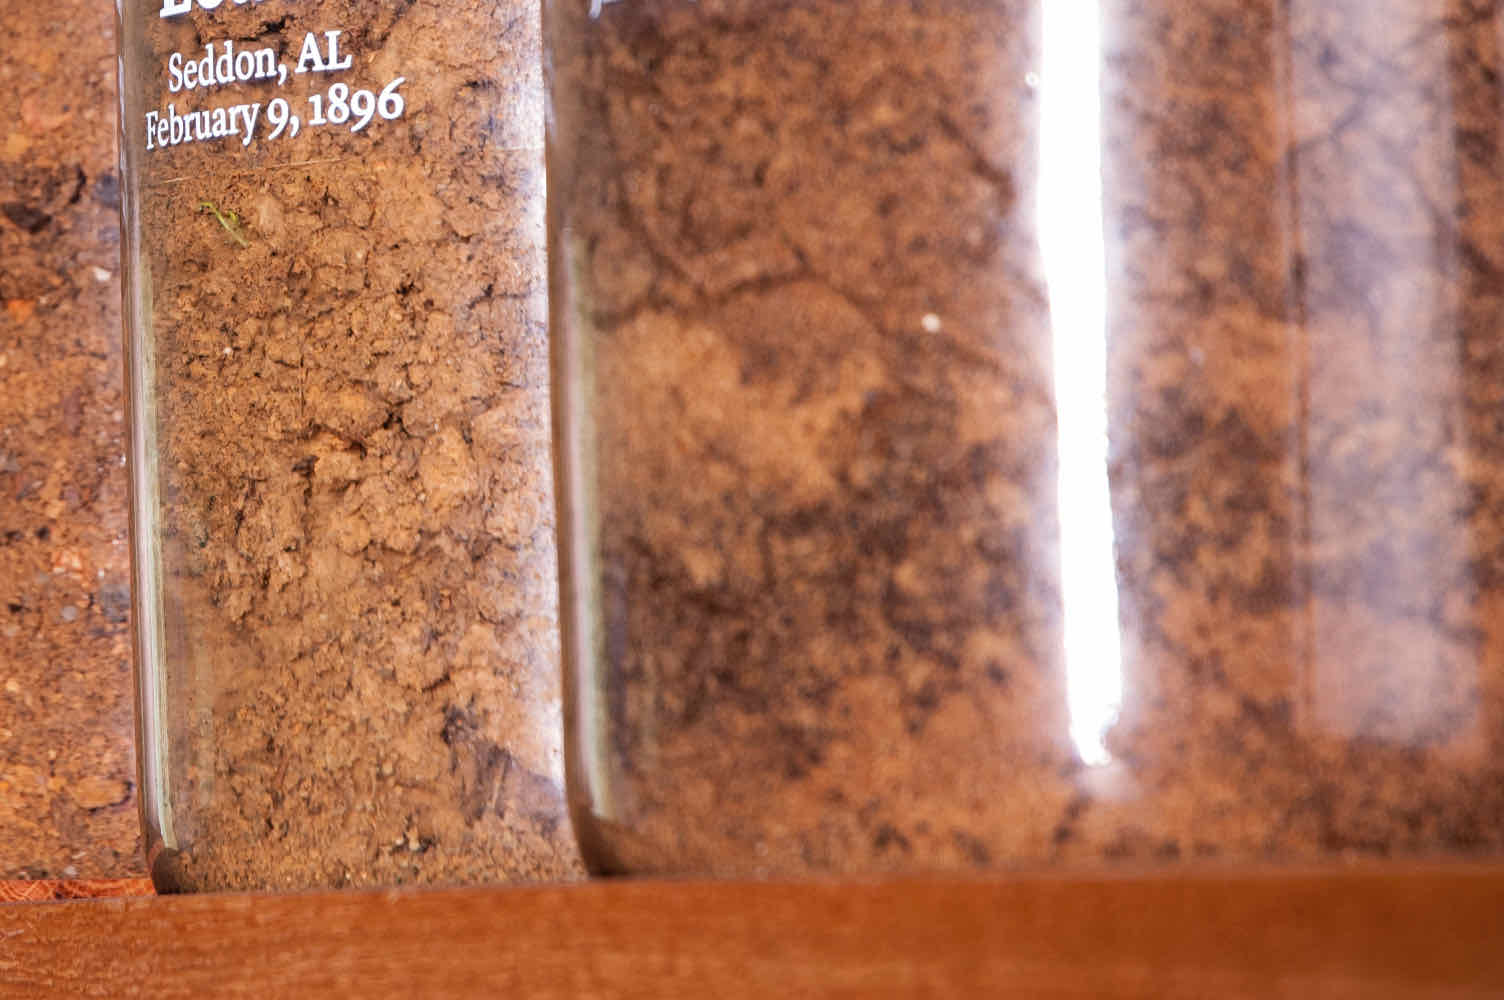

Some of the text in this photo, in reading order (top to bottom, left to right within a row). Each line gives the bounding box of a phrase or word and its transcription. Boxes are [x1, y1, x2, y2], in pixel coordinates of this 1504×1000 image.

[168, 30, 353, 93] Seddon, AL
[146, 76, 406, 150] February 9, 1896
